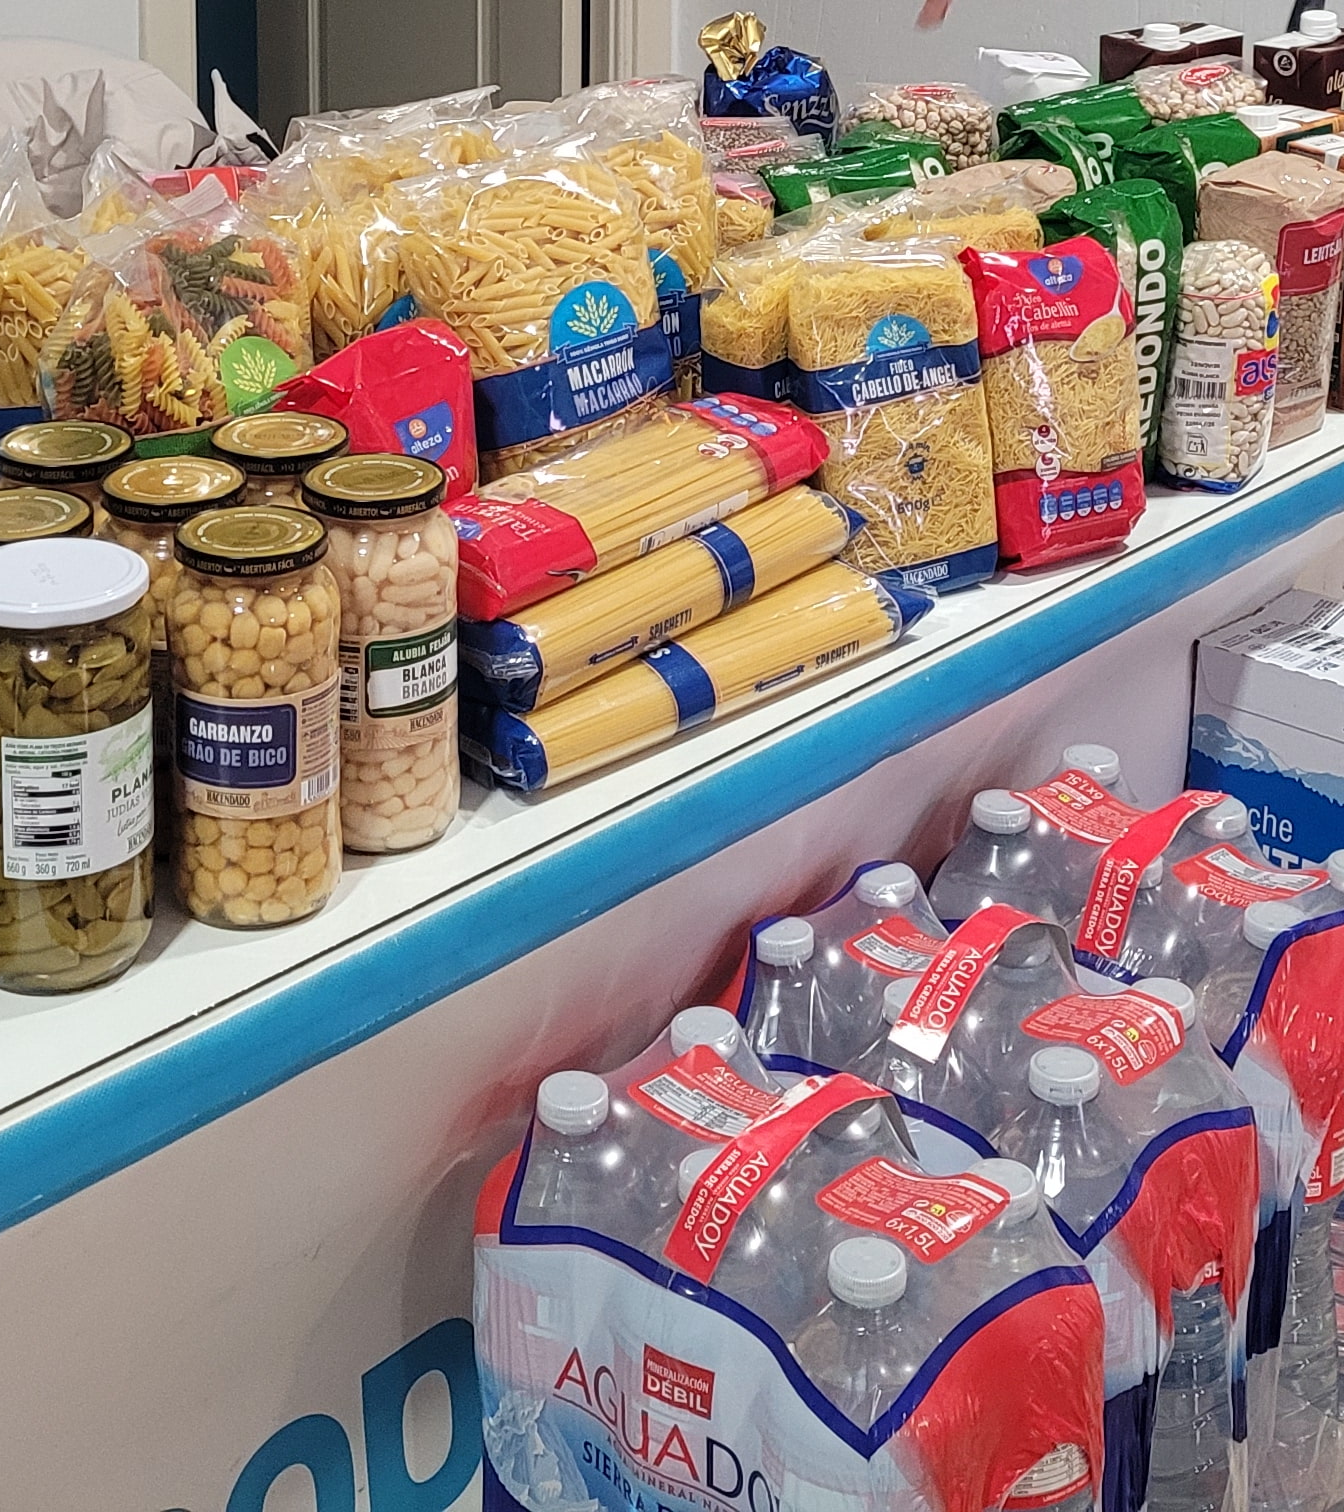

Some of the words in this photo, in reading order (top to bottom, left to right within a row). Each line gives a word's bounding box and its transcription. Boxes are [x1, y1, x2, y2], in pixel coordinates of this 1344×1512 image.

[566, 346, 635, 392] MACARRÓN
[889, 358, 914, 376] FIDEO
[573, 372, 644, 418] MACARRÃO
[852, 374, 903, 406] CABELLO
[904, 371, 920, 392] DE
[922, 363, 957, 388] ÁNGEL
[410, 432, 443, 455] alteza
[902, 563, 949, 586] HACENDADO
[648, 607, 693, 641] SPAGHETTI
[392, 644, 427, 662] ALUBIA
[402, 654, 447, 683] BLANCA
[814, 639, 861, 670] SPAGHETTI
[402, 671, 447, 700] BRANCO
[189, 716, 273, 744] GARBANZO
[219, 748, 243, 767] DE
[248, 746, 288, 768] BICO
[207, 790, 251, 807] HACENDADO
[1250, 801, 1294, 845] che
[66, 860, 80, 873] 720
[82, 858, 91, 870] ml
[694, 1150, 771, 1262] AGUADOY
[885, 1217, 937, 1257] 6x1,5L
[646, 1358, 710, 1394] MINERALIZACIÓN
[646, 1373, 709, 1414] DÉBIL
[554, 1346, 780, 1512] AGUADO
